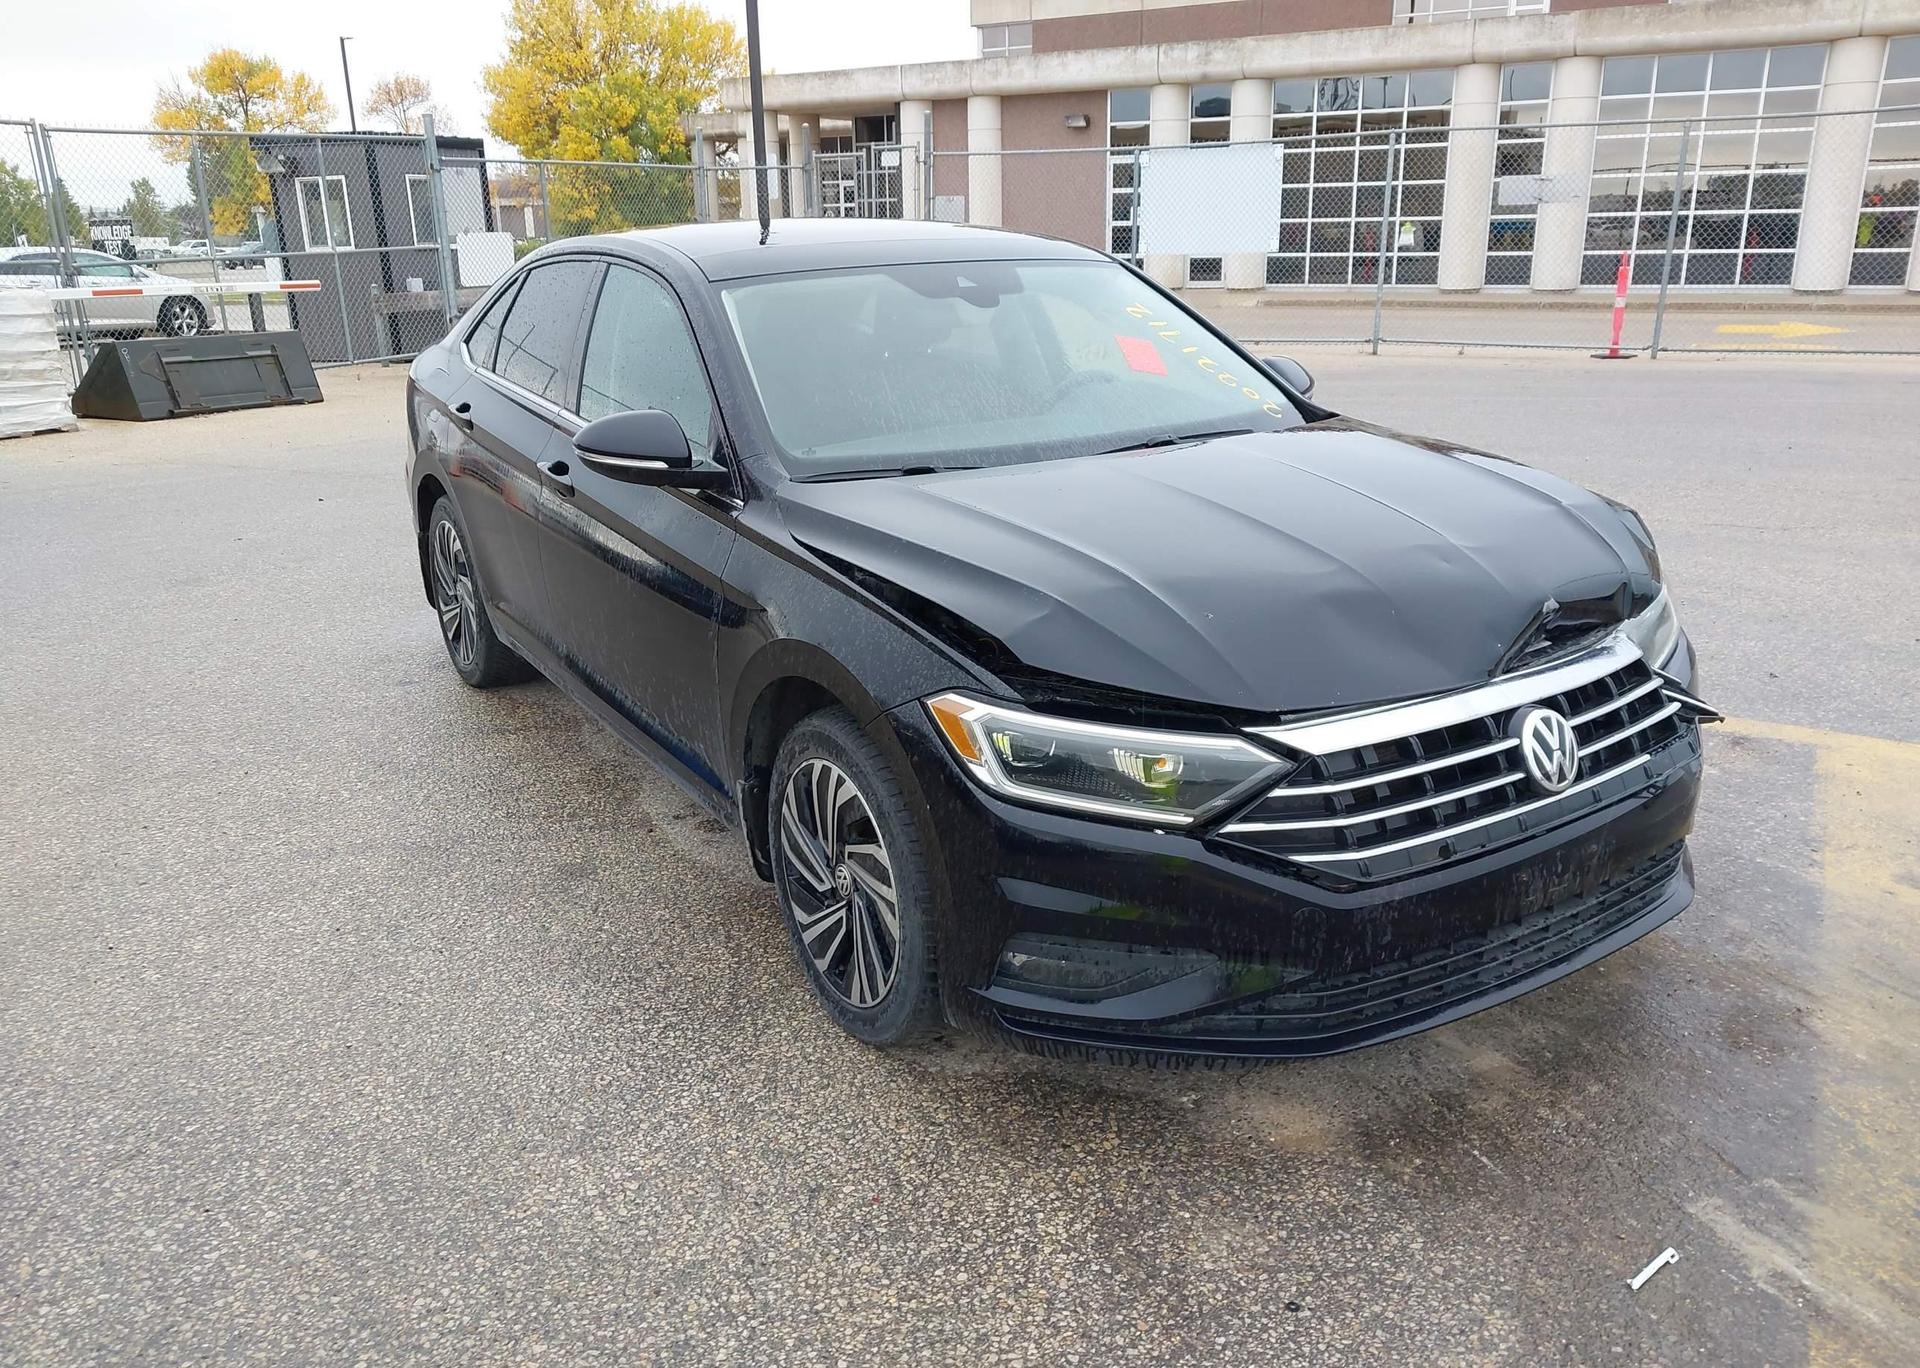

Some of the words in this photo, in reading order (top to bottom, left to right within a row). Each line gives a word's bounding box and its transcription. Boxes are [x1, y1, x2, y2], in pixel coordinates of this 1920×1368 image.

[91, 225, 132, 240] KNOWLEDGE
[104, 240, 123, 255] TEST
[1525, 711, 1576, 790] VW
